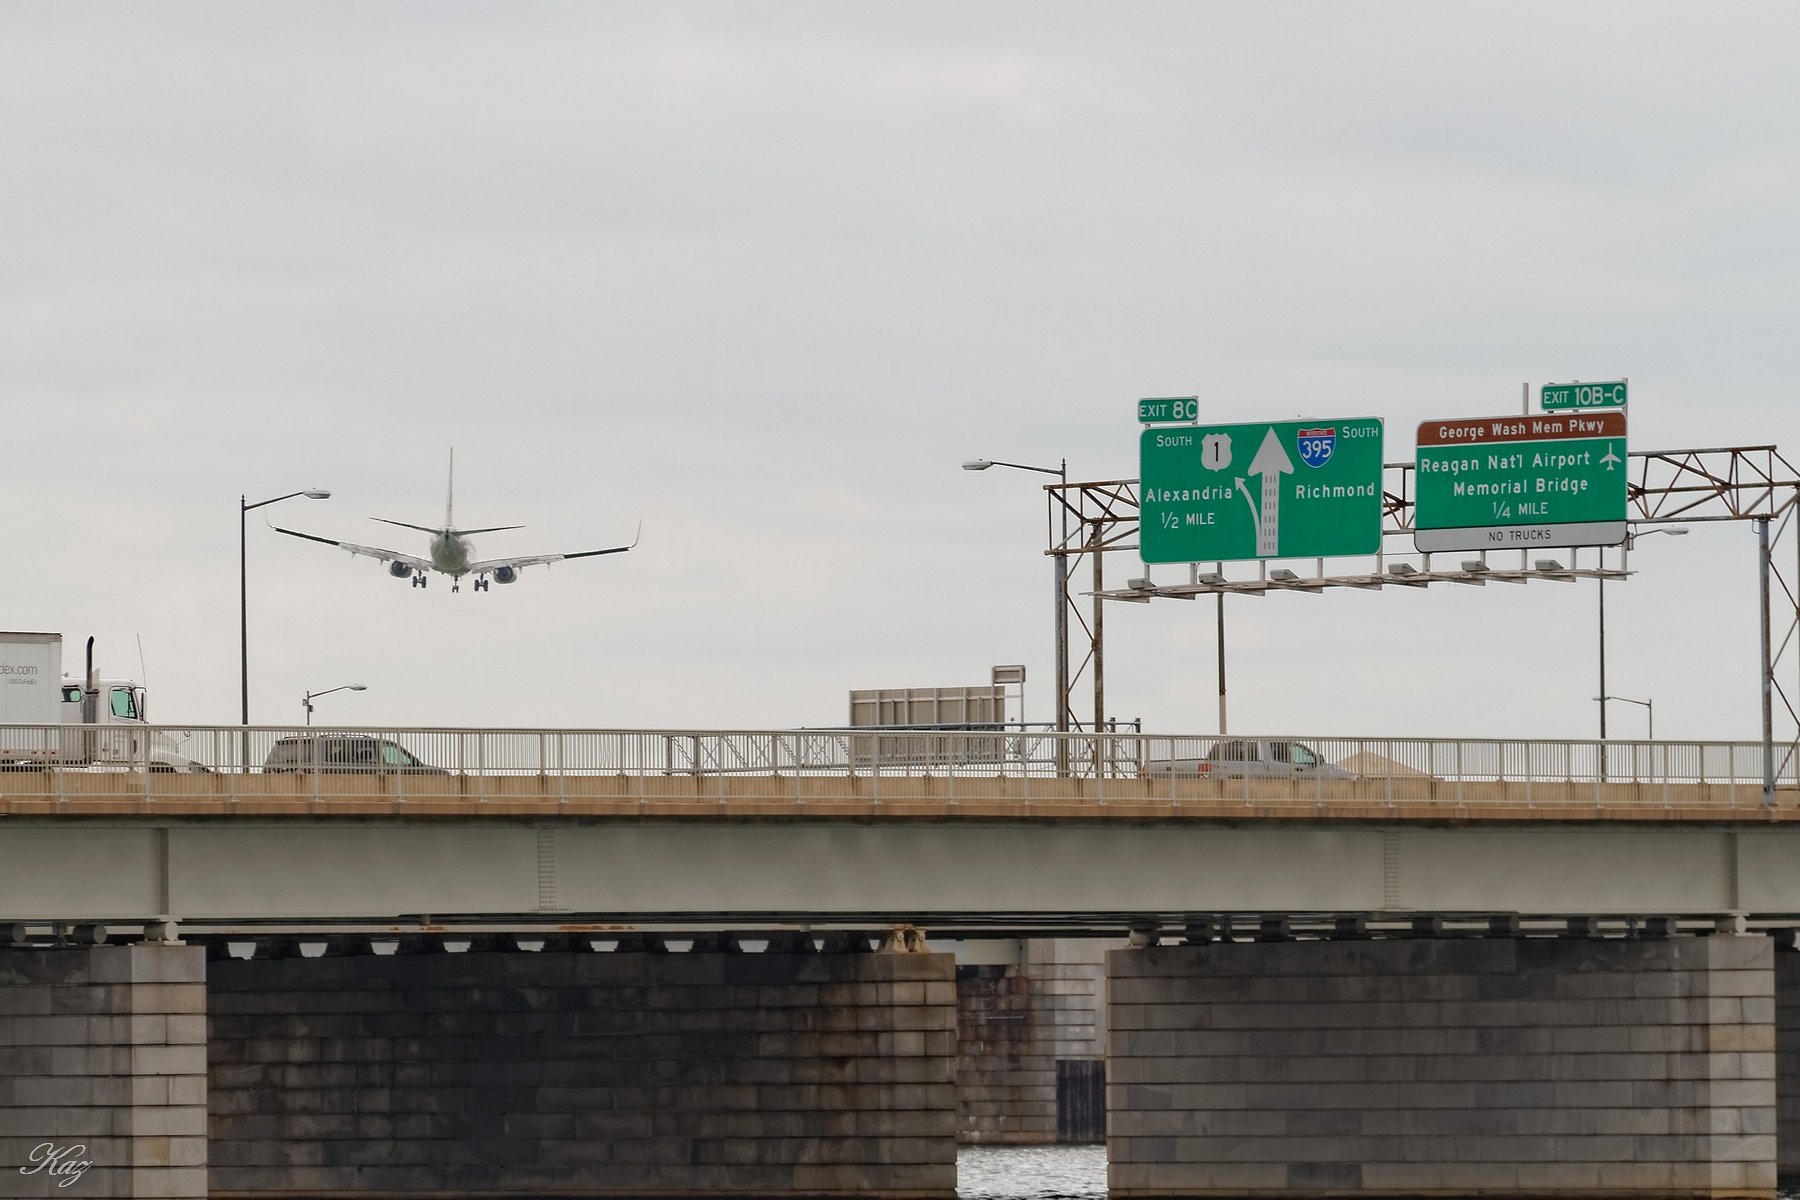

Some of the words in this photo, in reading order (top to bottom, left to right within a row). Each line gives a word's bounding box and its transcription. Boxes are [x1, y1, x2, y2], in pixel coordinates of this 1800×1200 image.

[1543, 391, 1570, 404] EXIT
[1575, 385, 1624, 406] 10B-C
[1140, 405, 1167, 417] EXIT
[1173, 400, 1197, 419] 8C
[1342, 426, 1379, 439] SOUTH
[1439, 424, 1485, 441] George
[1492, 421, 1526, 437] Wash
[1532, 420, 1563, 435] Mem
[1569, 418, 1605, 434] Pkwy
[1156, 434, 1192, 448] SOUTH
[1302, 440, 1332, 459] 395
[1214, 441, 1219, 462] 1
[1421, 457, 1479, 475] Reagan
[1488, 454, 1523, 470] Nat'l
[1532, 451, 1590, 470] Airport
[1146, 485, 1233, 503] Alexandria
[1295, 482, 1375, 500] Richmond
[1453, 479, 1527, 497] Memorial
[1536, 477, 1588, 495] Bridge
[1518, 502, 1549, 516] MILE
[1186, 512, 1216, 526] MILE
[1488, 531, 1504, 542] NO
[1509, 529, 1551, 541] TRUCKS
